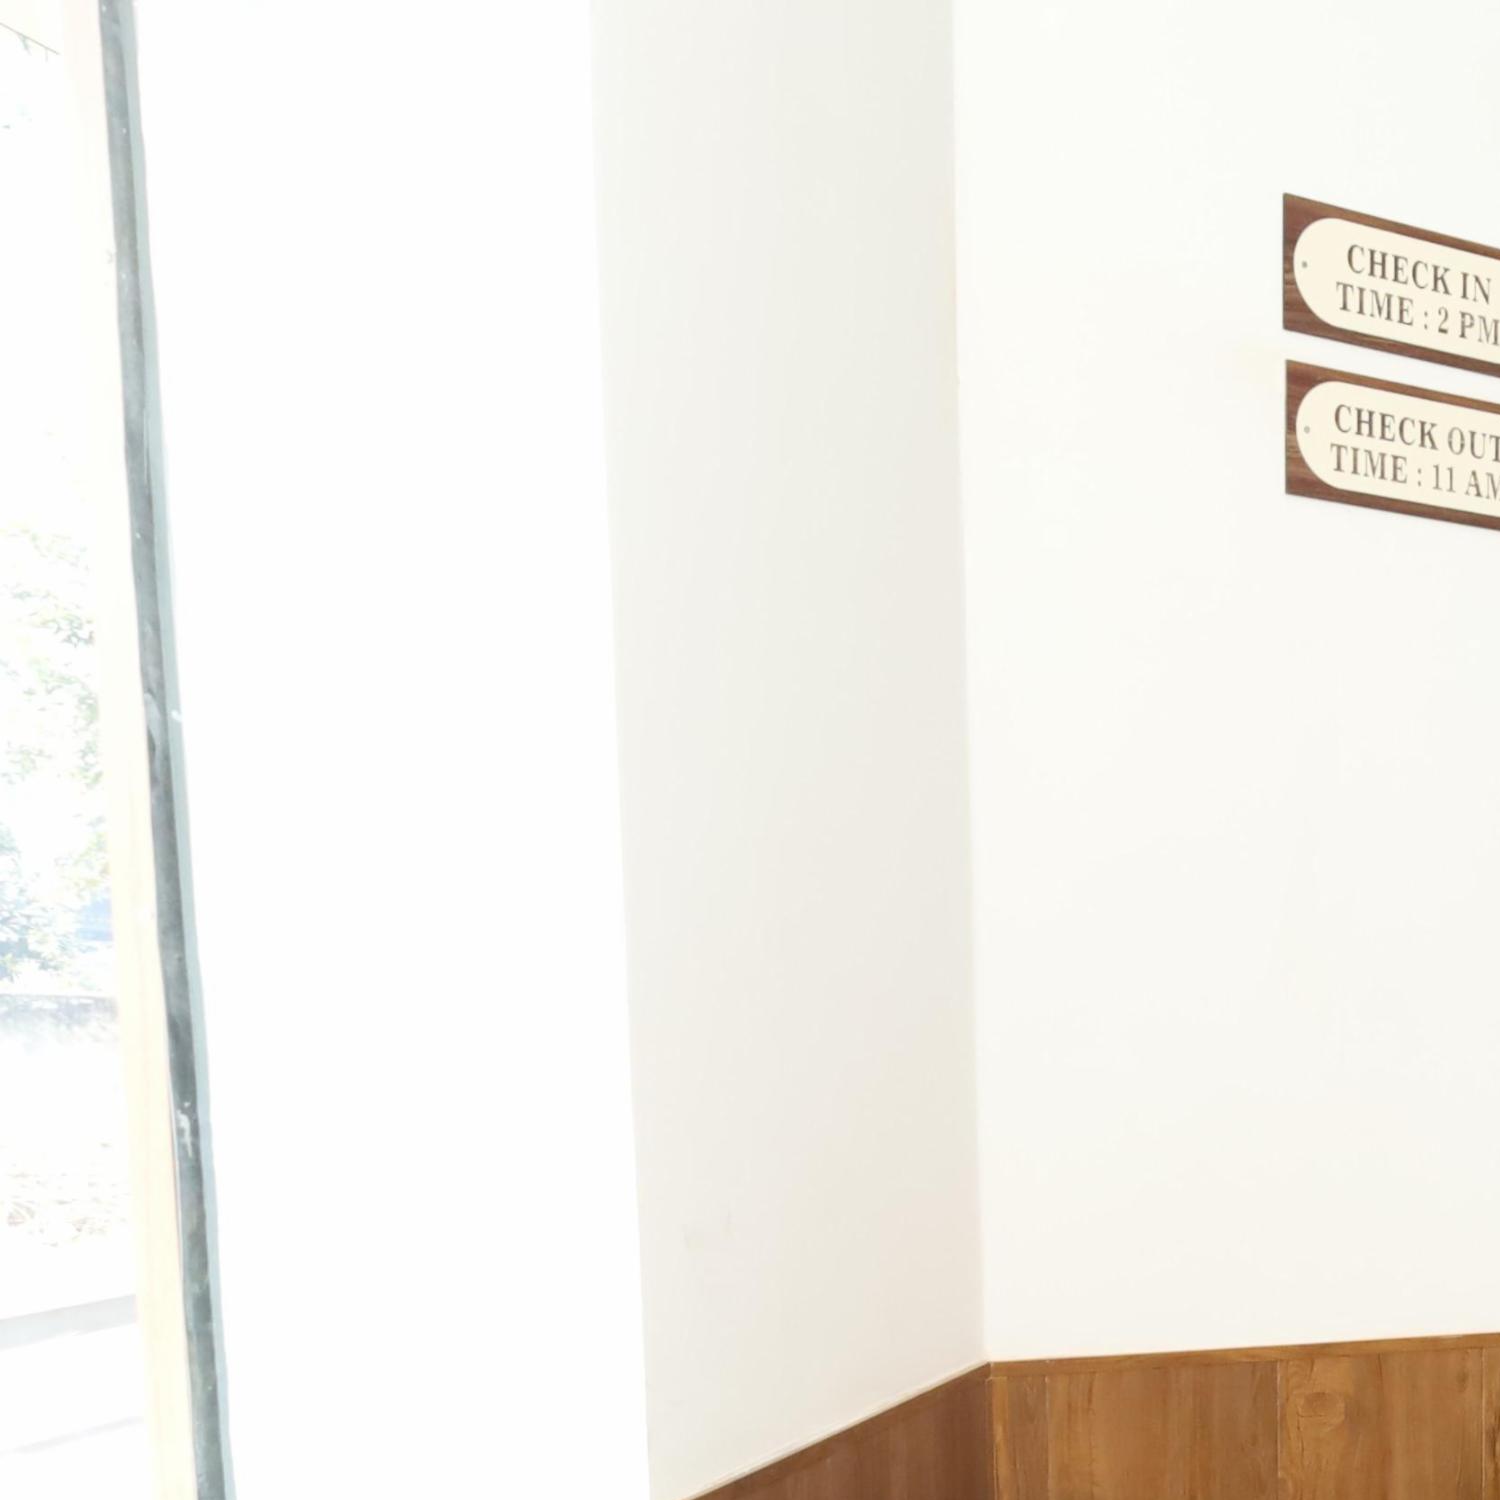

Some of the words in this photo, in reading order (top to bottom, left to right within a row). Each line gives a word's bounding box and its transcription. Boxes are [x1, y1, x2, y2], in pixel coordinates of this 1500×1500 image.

[1347, 244, 1451, 296] CHECK
[1460, 271, 1492, 305] IN
[1336, 281, 1414, 327] TIME
[1437, 307, 1449, 334] 2
[1458, 311, 1500, 346] PM
[1334, 404, 1438, 451] CHECK
[1330, 443, 1408, 484] TIME
[1433, 464, 1457, 493] 11
